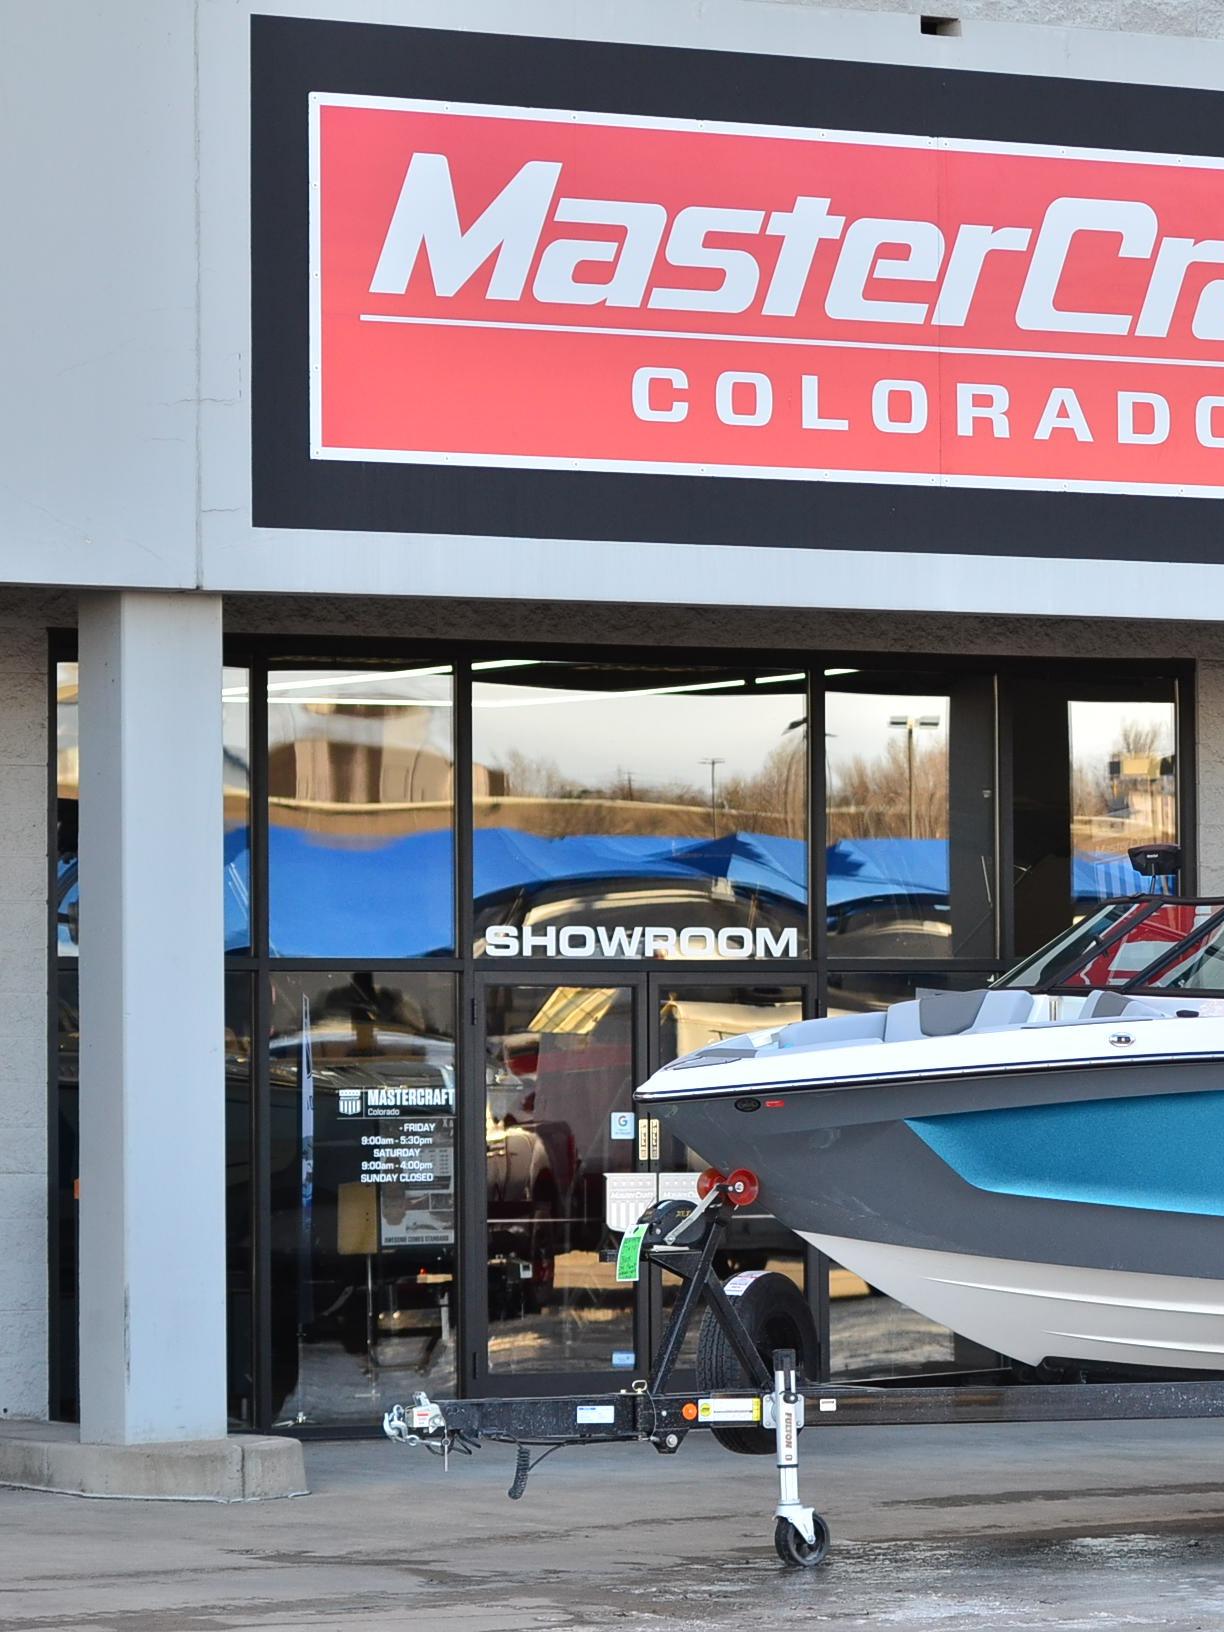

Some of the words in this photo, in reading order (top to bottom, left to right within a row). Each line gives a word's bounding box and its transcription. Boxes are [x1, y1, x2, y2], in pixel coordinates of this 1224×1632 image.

[484, 925, 799, 958] SHOWROOM
[367, 1087, 455, 1106] MASTERCRAFT
[367, 1107, 400, 1116] Colorado
[403, 1122, 436, 1132] FRIDAY
[361, 1135, 394, 1145] 9:00am
[399, 1135, 433, 1146] 5:30pm
[373, 1147, 421, 1158] SATURDAY
[361, 1160, 394, 1171] 9:00am
[399, 1160, 433, 1172] 4:00pm
[360, 1173, 398, 1183] SUNDAY
[399, 1172, 434, 1182] CLOSED
[784, 1411, 793, 1449] FULTON
